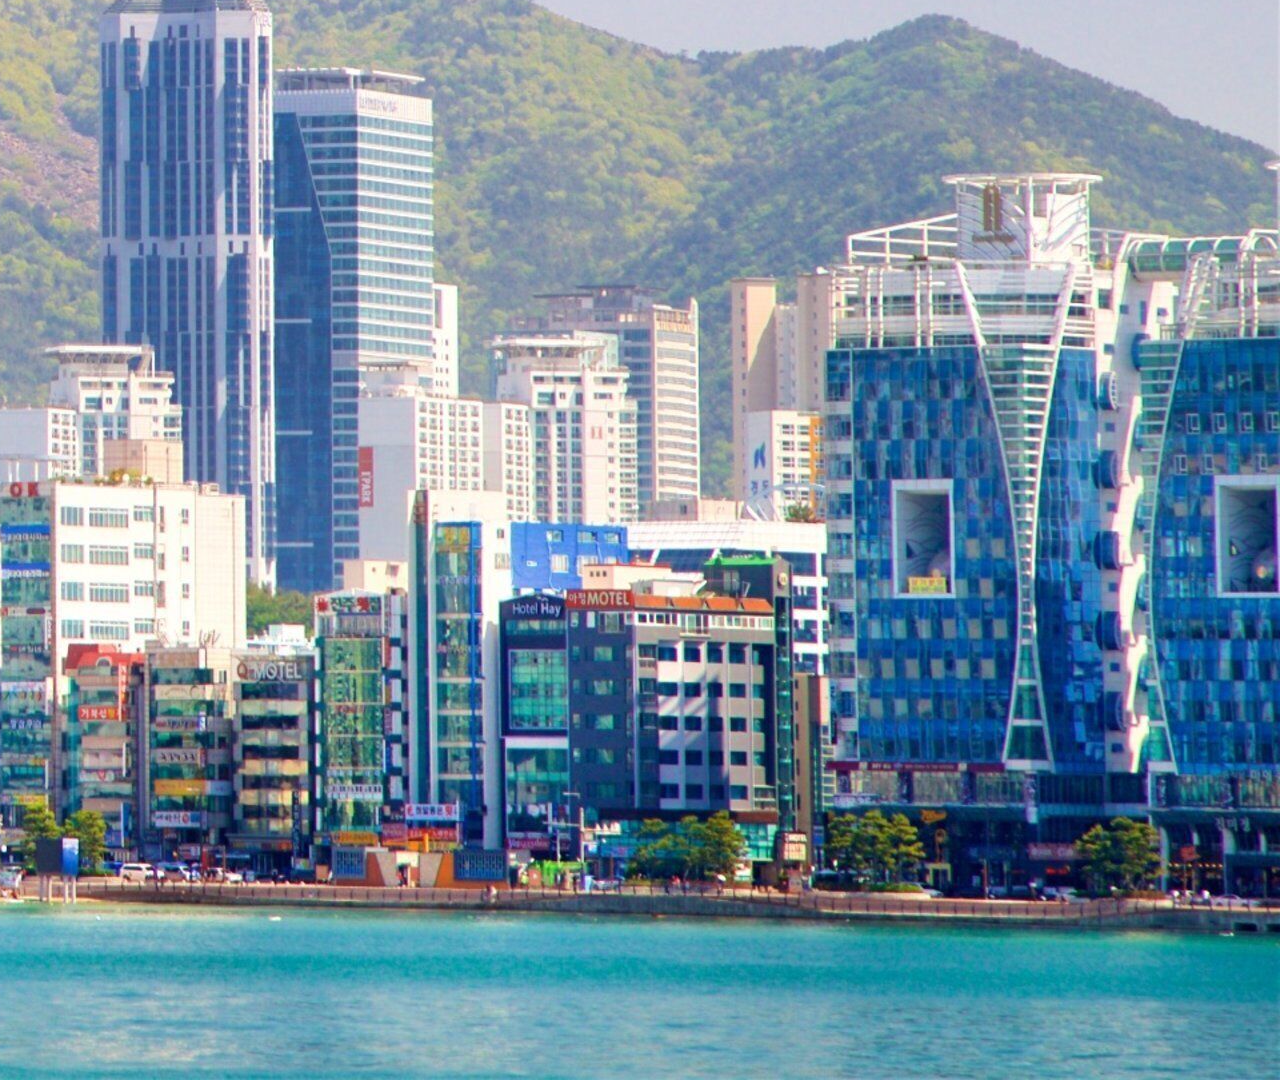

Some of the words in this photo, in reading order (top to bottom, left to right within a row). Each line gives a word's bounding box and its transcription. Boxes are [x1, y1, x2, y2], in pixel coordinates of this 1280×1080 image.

[587, 591, 630, 606] MOTEL
[512, 602, 538, 614] Hotel
[540, 602, 561, 617] Hay
[254, 662, 302, 680] MOTEL
